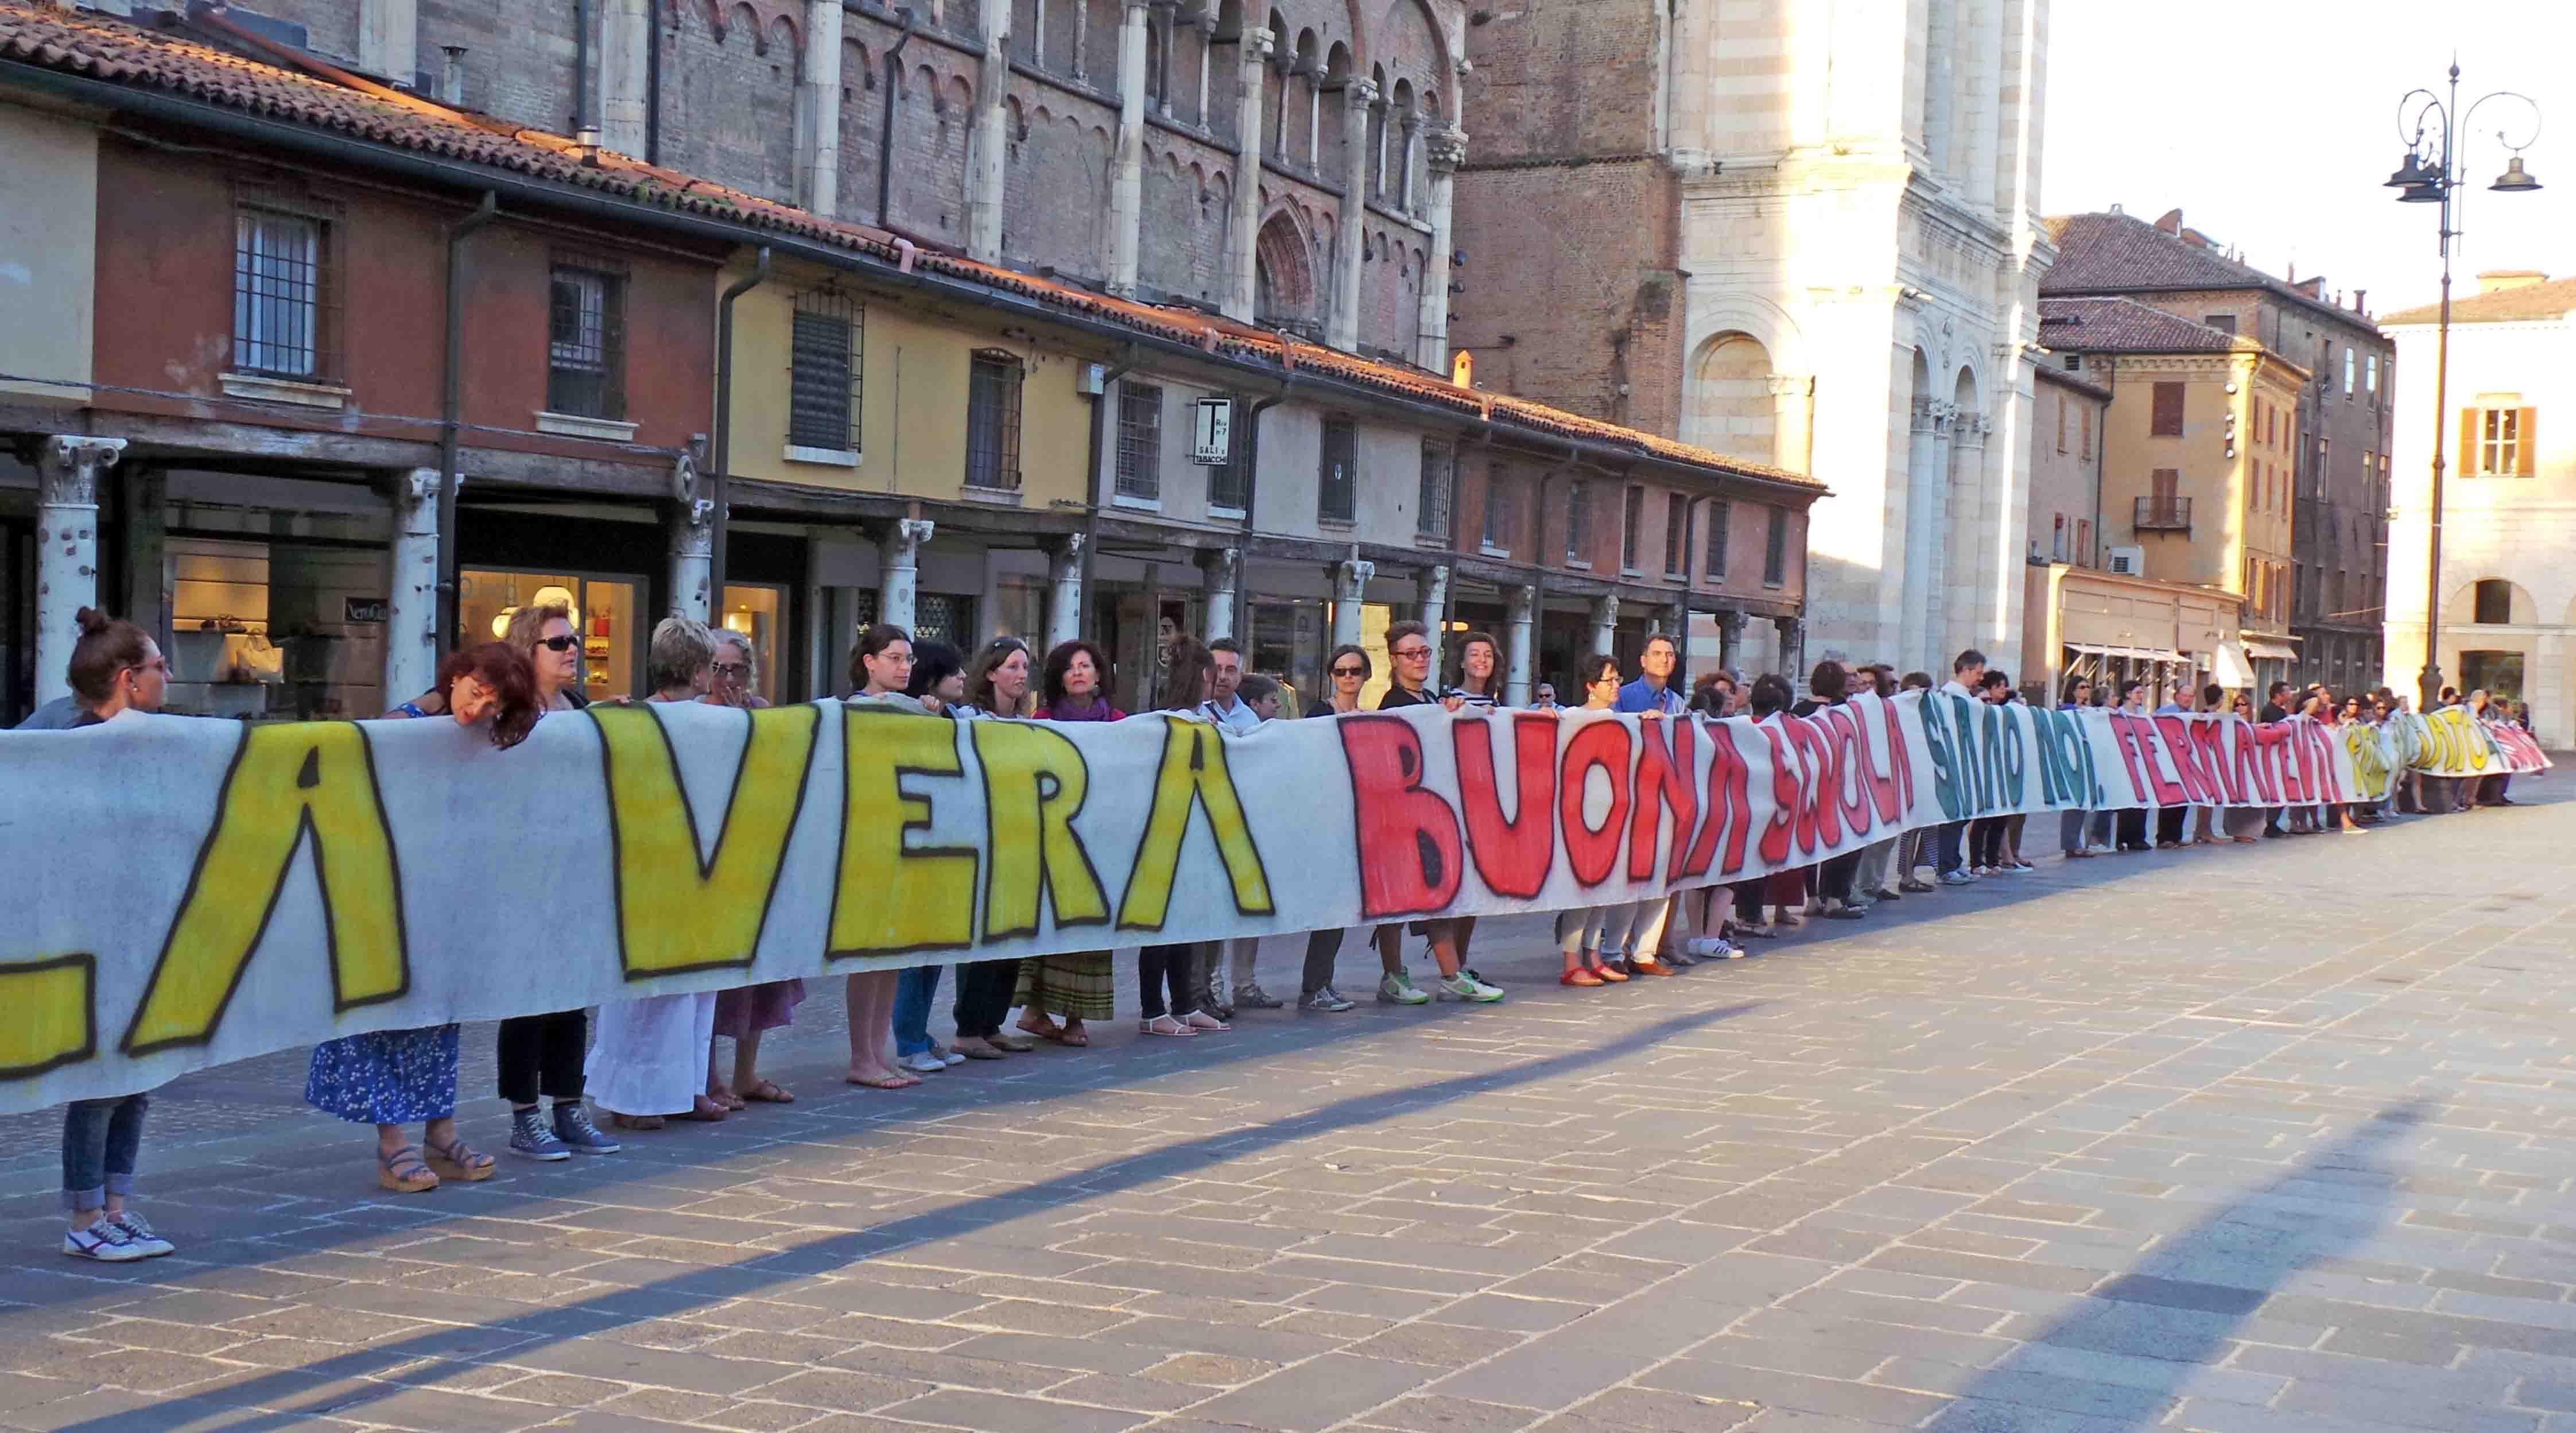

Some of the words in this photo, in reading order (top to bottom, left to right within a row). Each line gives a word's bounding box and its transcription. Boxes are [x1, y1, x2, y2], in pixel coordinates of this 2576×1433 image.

[1200, 401, 1227, 446] T
[1199, 446, 1218, 454] SALI
[584, 698, 1277, 982] VERA
[1337, 714, 1748, 920] BUONA
[1758, 697, 1915, 866] SCUOLA
